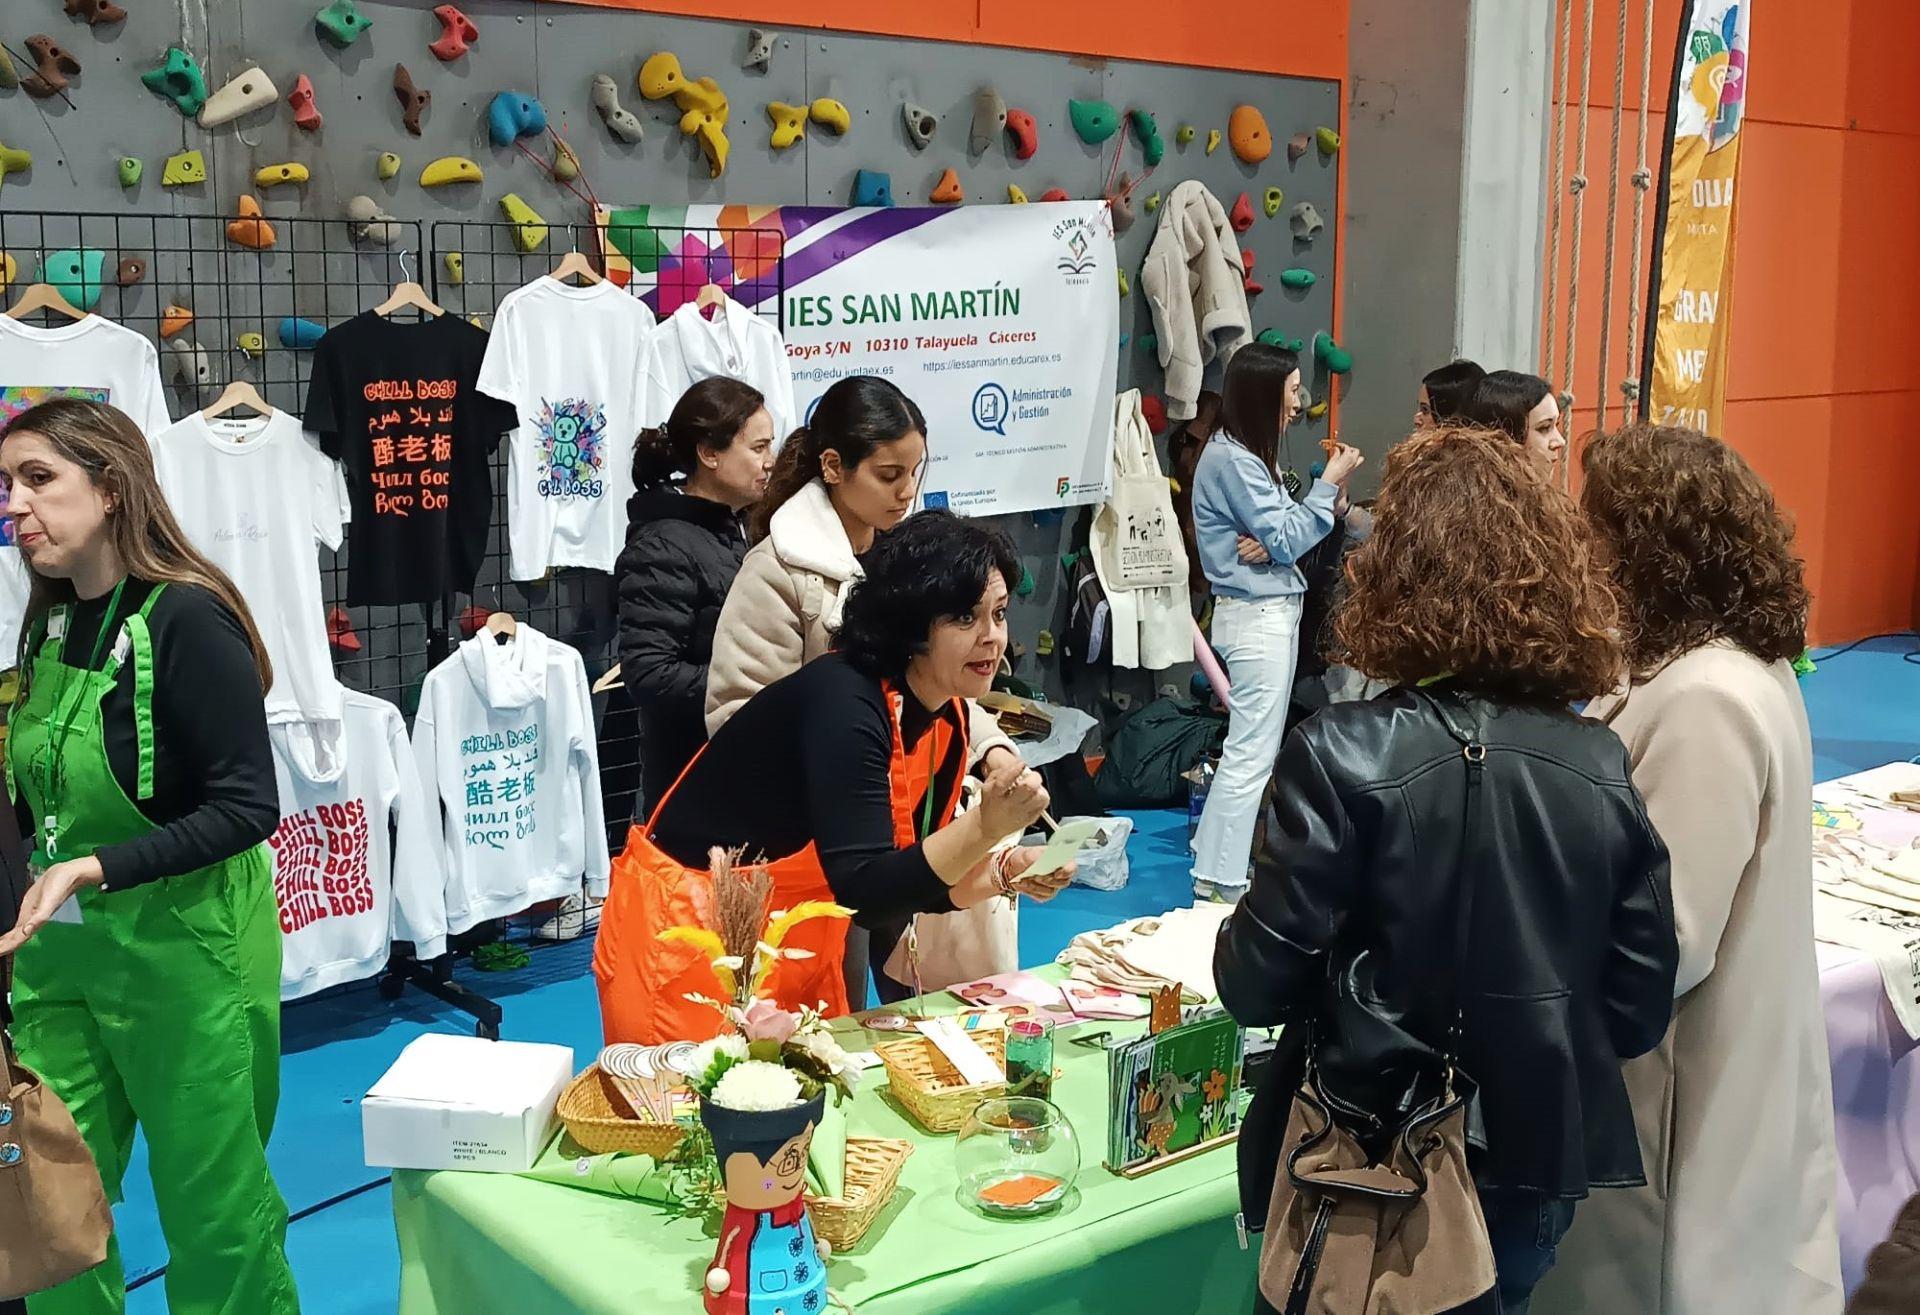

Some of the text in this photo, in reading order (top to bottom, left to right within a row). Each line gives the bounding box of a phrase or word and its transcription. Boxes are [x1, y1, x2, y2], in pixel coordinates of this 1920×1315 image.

[789, 281, 1020, 327] IES SAN MARTÍN
[784, 331, 1037, 360] Goya S/N 10310 Talayuela Cáceres
[363, 379, 457, 401] CHILL BOSS
[1012, 385, 1072, 402] Administración
[1018, 405, 1050, 419] Gestión
[371, 433, 452, 468] 酷老板
[461, 723, 538, 756] CHILL BOSS
[465, 770, 535, 808] 酷老板
[267, 797, 364, 849] CHILL BOSS
[277, 816, 368, 869] CHILL BOSS
[274, 846, 321, 886] CHILL
[275, 863, 367, 909] CHILL BOSS
[279, 877, 373, 934] CHILL BOSS
